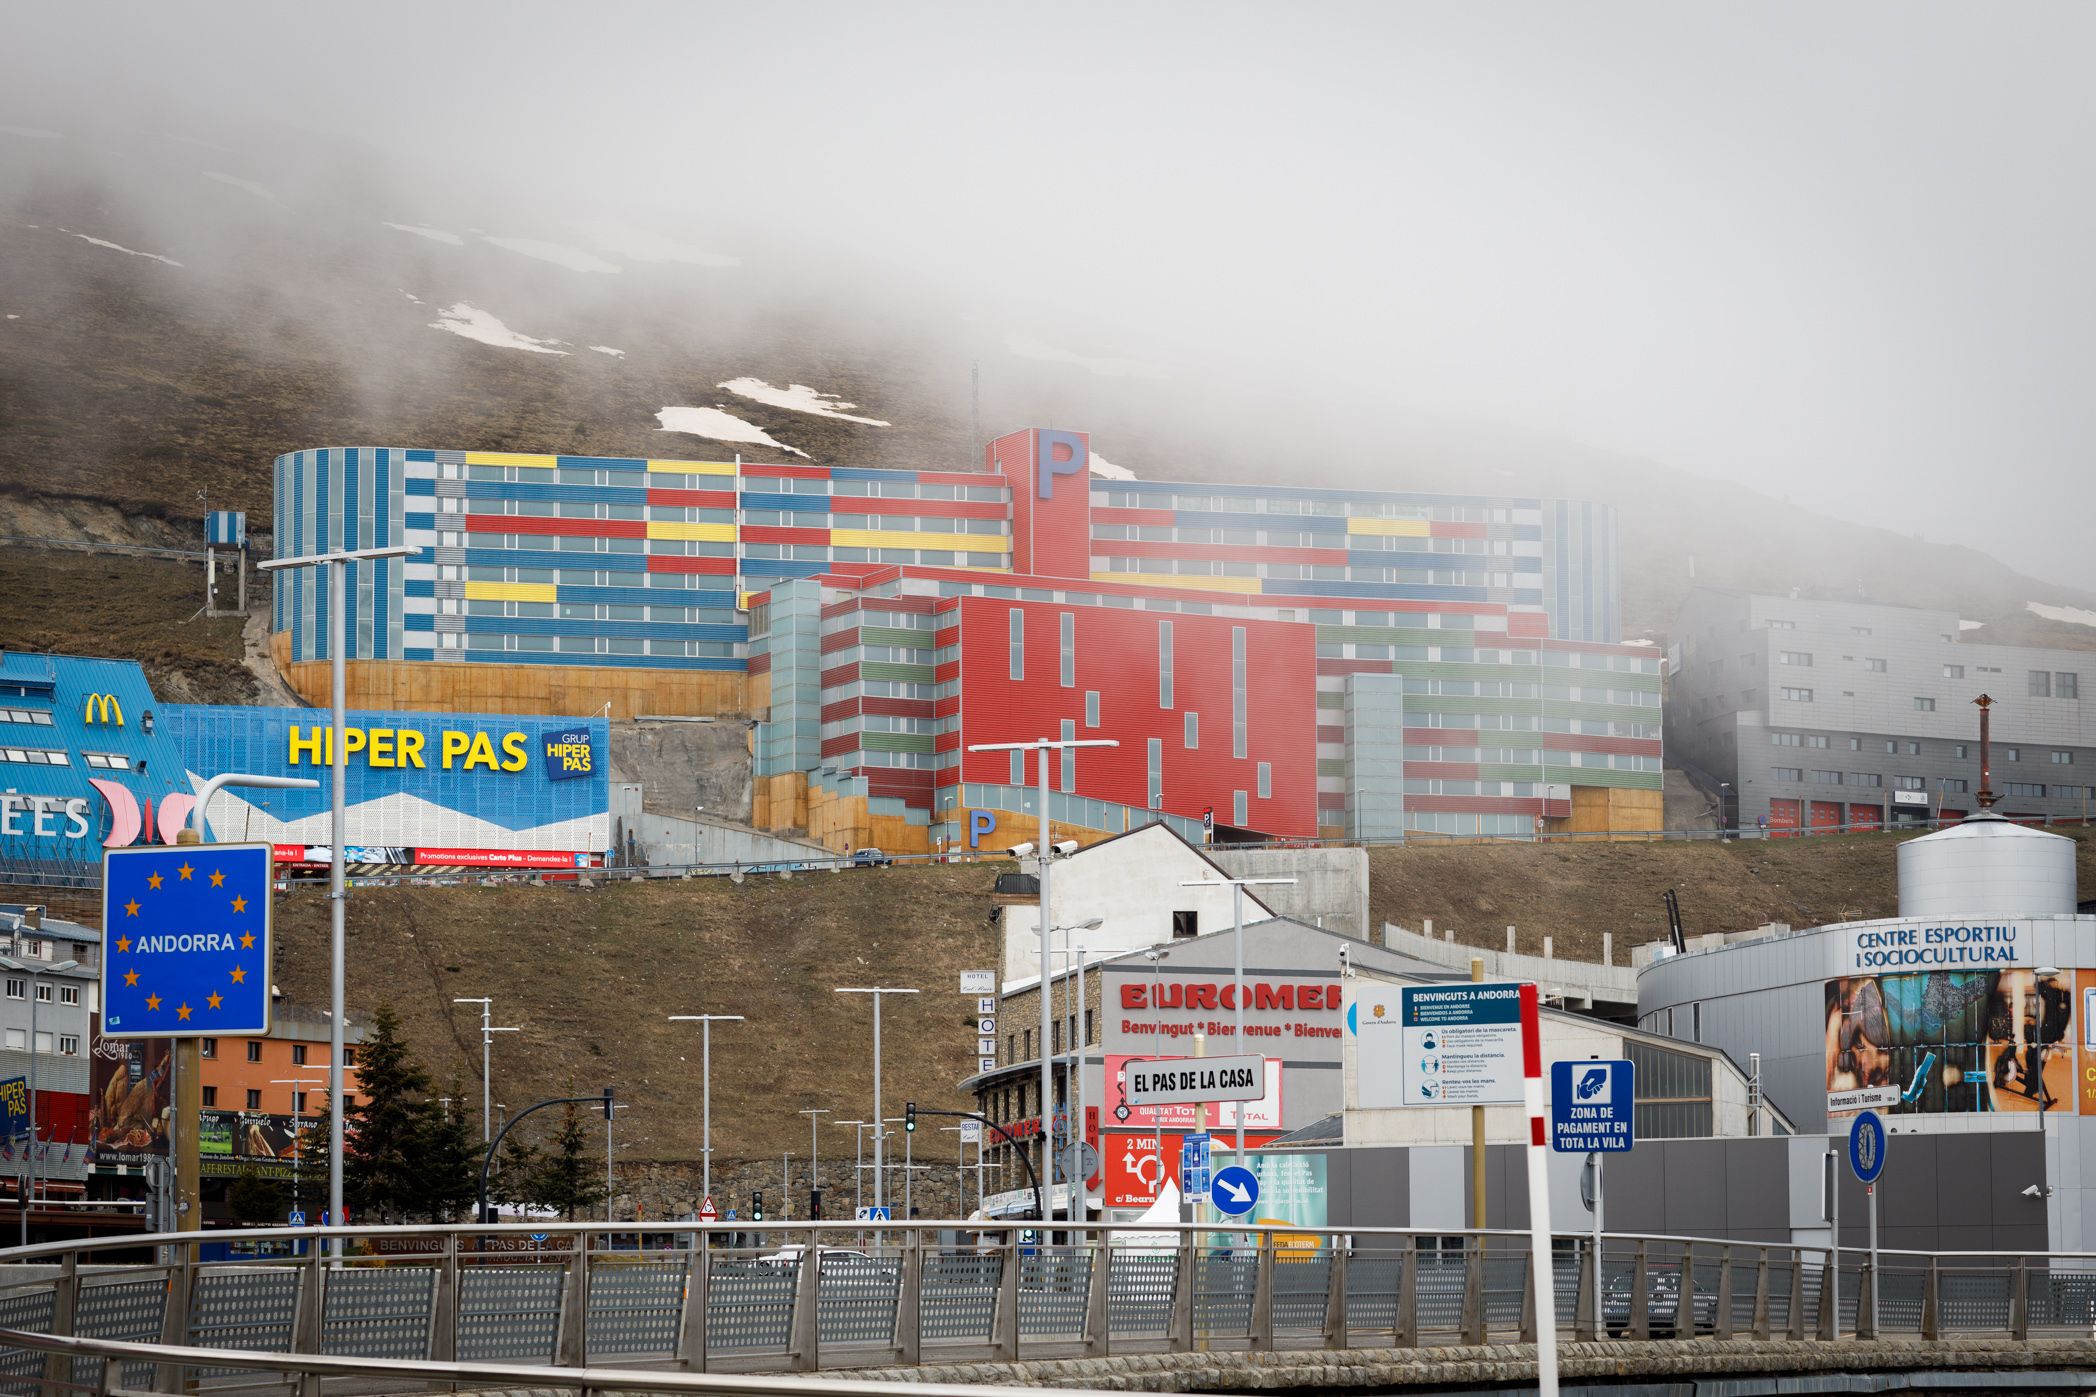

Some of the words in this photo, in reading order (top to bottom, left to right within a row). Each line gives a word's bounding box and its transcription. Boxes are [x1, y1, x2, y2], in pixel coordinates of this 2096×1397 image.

[1039, 430, 1086, 499] P
[562, 734, 590, 743] GRUP
[289, 725, 426, 768] HIPER
[442, 730, 528, 772] PAS
[547, 744, 591, 758] HIPER
[563, 757, 592, 772] PAS
[969, 809, 997, 848] P
[420, 852, 456, 860] Promotions
[457, 853, 488, 861] exclusives
[489, 853, 507, 861] Carte
[508, 854, 522, 862] Plus
[527, 855, 568, 863] Demandez-la
[135, 932, 236, 954] ANDORRA
[1857, 929, 1917, 949] CENTRE
[1925, 926, 2016, 944] ESPORTIU
[1864, 945, 2019, 967] SOCIOCULTURAL
[1413, 991, 1468, 1003] BENVINGUTS
[1469, 990, 1476, 1000] A
[1477, 989, 1521, 1000] ANDORRA
[1134, 1074, 1149, 1093] EL
[1152, 1072, 1176, 1092] PAS
[1180, 1071, 1196, 1090] DE
[1200, 1069, 1216, 1089] LA
[1219, 1068, 1254, 1088] CASA
[8, 1097, 27, 1117] PAS
[1830, 1095, 1857, 1107] Informació
[1861, 1093, 1882, 1103] Turisme
[1139, 1106, 1173, 1116] QUALTAT
[1174, 1105, 1212, 1116] TOTL
[1230, 1110, 1269, 1121] TTAL
[1570, 1107, 1598, 1119] ZONA
[1600, 1107, 1613, 1118] DE
[289, 1117, 318, 1130] Srrano
[1557, 1122, 1611, 1134] PAGAMENT
[1614, 1121, 1627, 1133] EN
[1127, 1138, 1134, 1150] 2
[1559, 1137, 1585, 1149] TOTA
[1587, 1137, 1600, 1148] LA
[1602, 1136, 1625, 1148] VILA
[380, 1240, 465, 1251] BENVINGUS
[492, 1239, 515, 1251] PAS
[518, 1239, 535, 1251] DE
